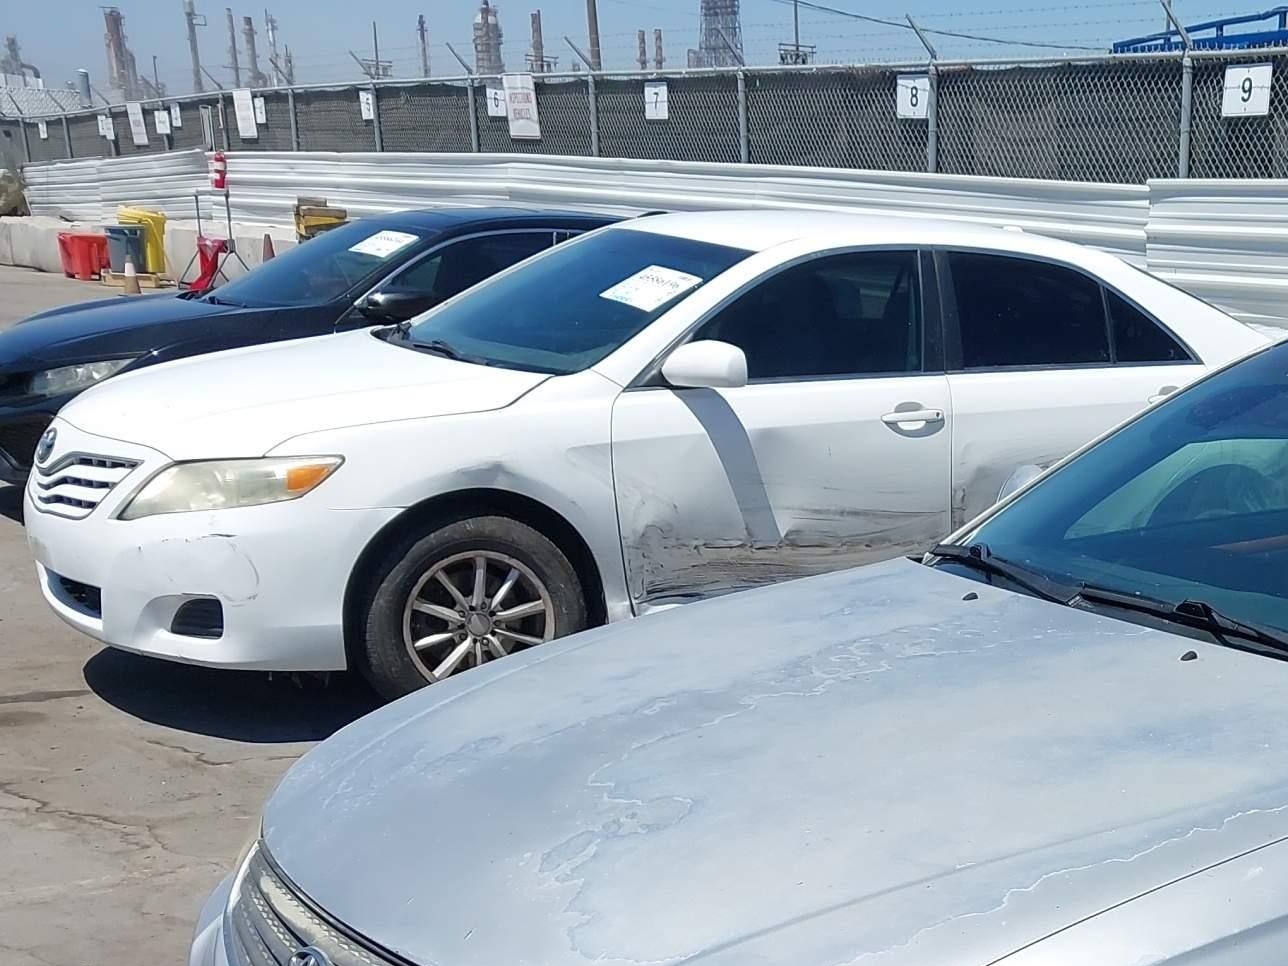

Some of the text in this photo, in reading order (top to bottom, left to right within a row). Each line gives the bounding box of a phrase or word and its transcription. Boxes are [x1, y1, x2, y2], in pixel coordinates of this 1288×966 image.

[910, 86, 919, 108] 8
[1240, 77, 1253, 103] 9
[493, 92, 499, 108] 6
[653, 92, 660, 109] 7
